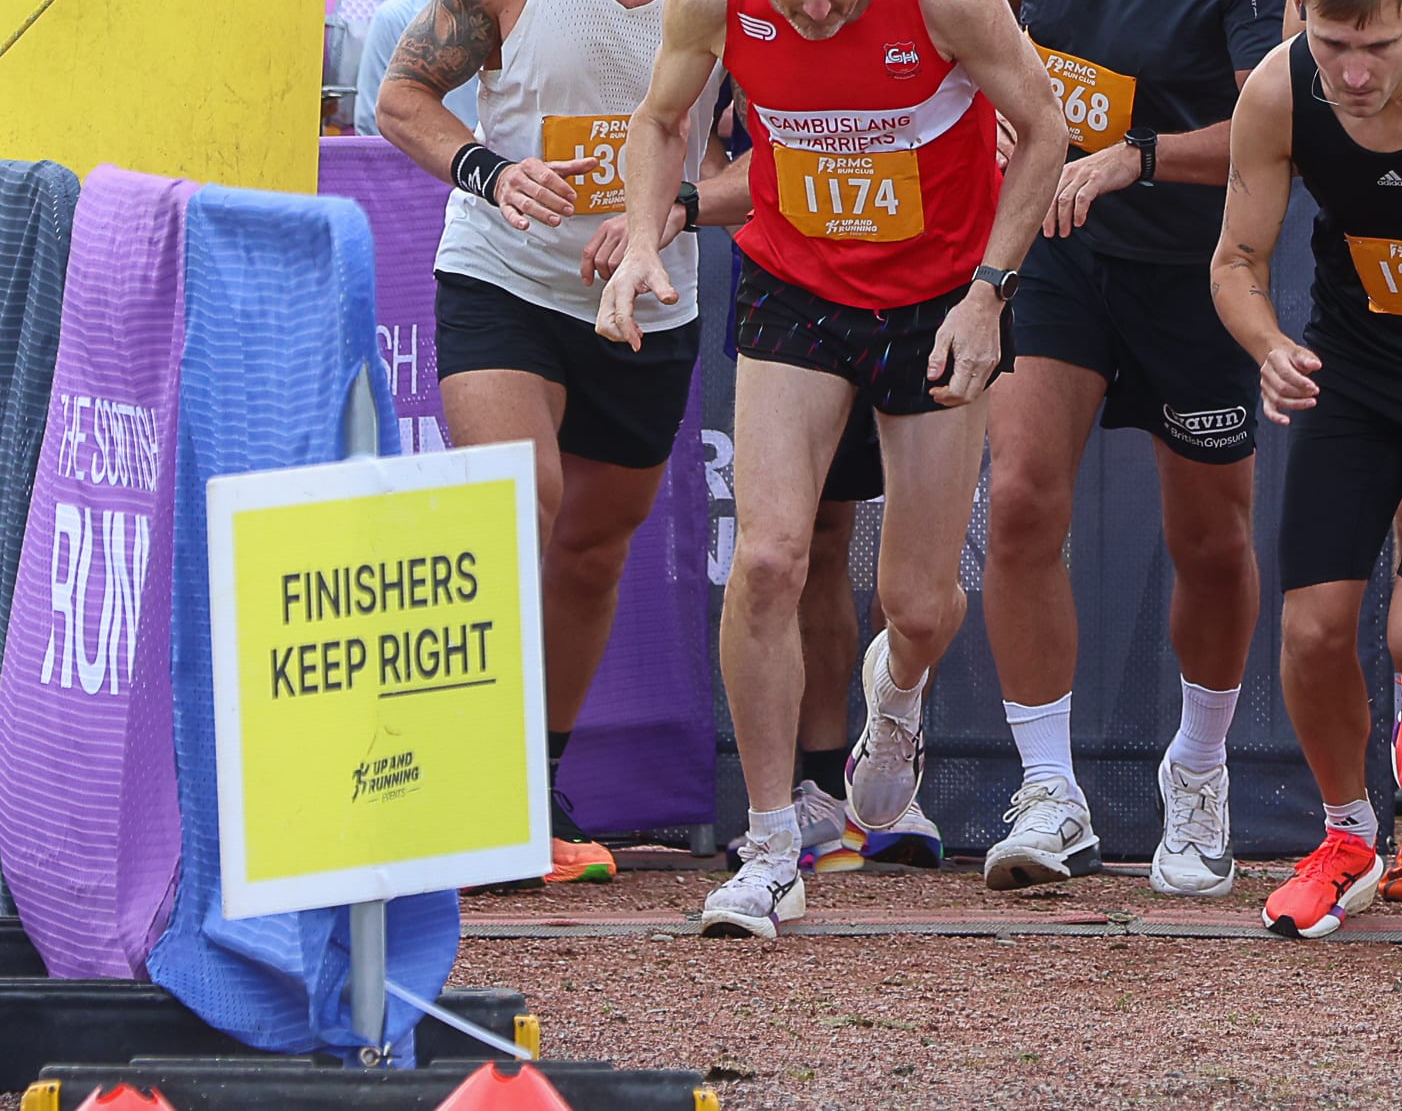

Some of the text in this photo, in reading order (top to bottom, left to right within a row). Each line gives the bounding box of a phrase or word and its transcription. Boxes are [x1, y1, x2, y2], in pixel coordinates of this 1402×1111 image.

[1062, 70, 1097, 86] RUN CLUB
[1064, 59, 1097, 79] RMC
[1049, 77, 1110, 132] 68
[609, 120, 629, 132] RM
[768, 115, 911, 135] CAMBUSLANG
[799, 133, 896, 153] HARRIERS
[575, 143, 627, 186] 13
[836, 157, 873, 168] RMC
[601, 197, 625, 205] RUNN
[804, 175, 899, 216] 1174
[838, 225, 878, 233] RUNNING
[40, 502, 150, 696] RUN
[281, 551, 479, 626] FINISHERS
[270, 620, 494, 700] KEEP RIGHT
[373, 751, 413, 776] UP AND
[368, 766, 419, 794] RUNNING
